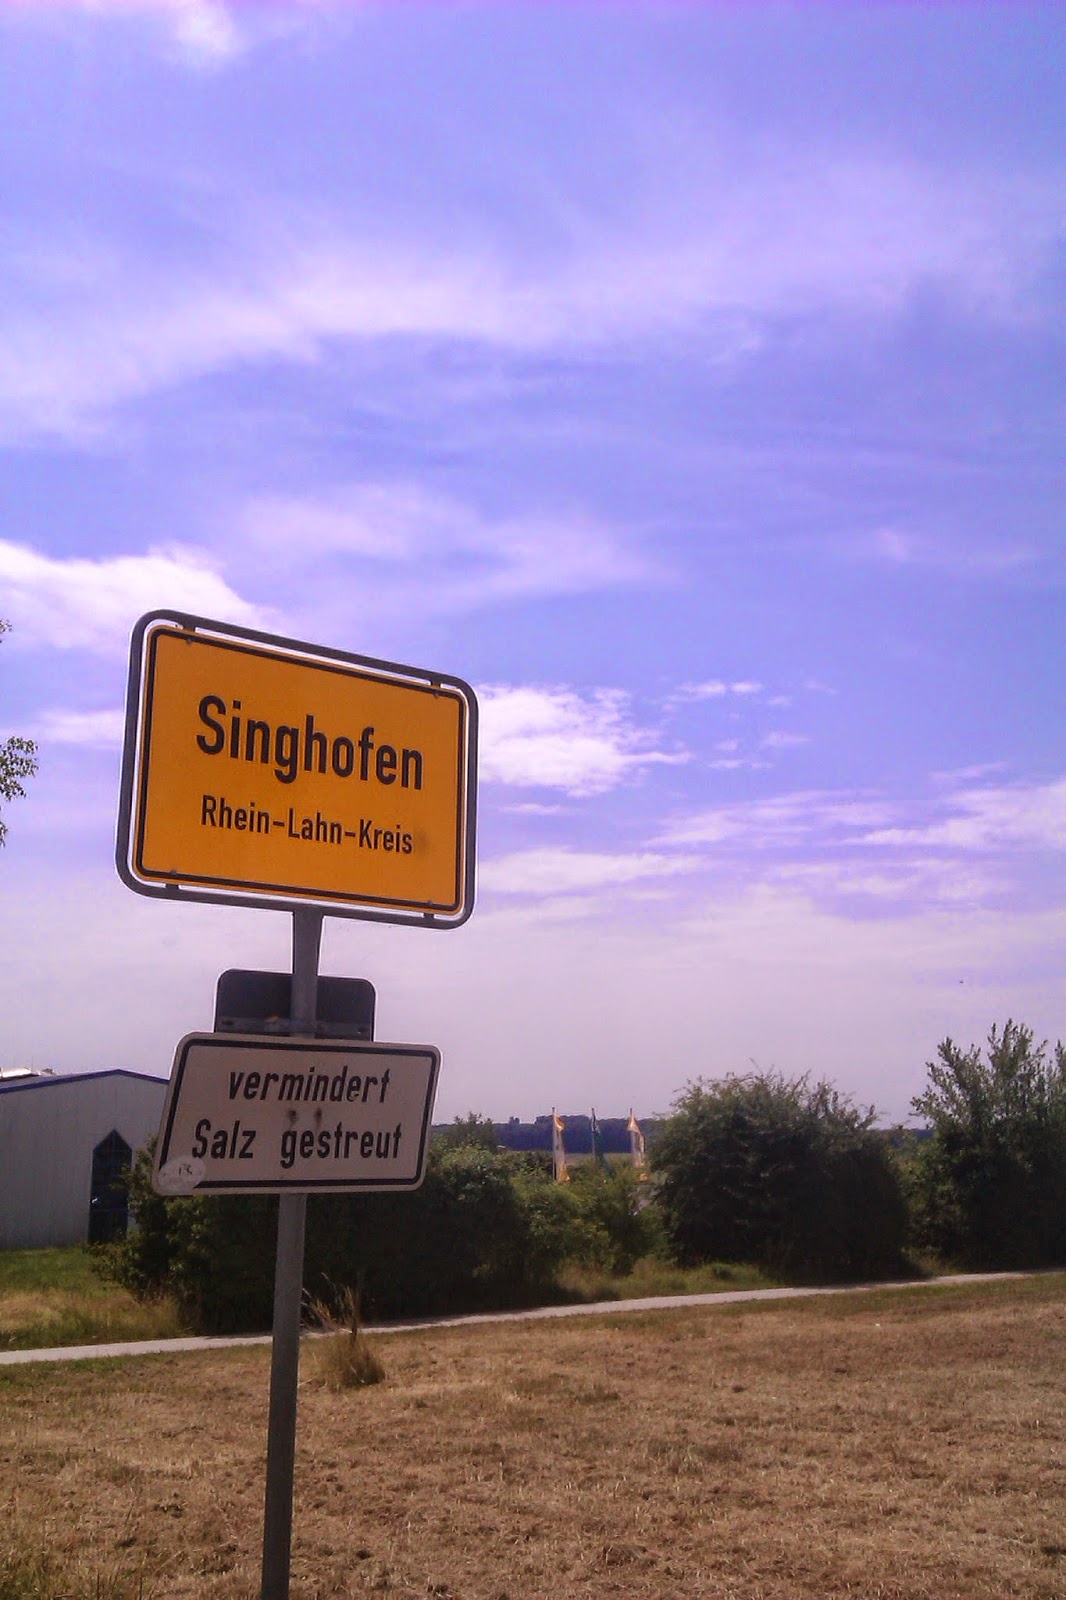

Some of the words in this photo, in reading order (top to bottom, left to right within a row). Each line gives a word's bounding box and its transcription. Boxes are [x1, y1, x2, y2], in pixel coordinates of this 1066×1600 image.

[196, 694, 423, 790] Singhofen
[201, 794, 413, 854] Rhein-Lahn-Kreis
[229, 1066, 390, 1103] vermindert
[192, 1119, 257, 1159] Salz
[279, 1121, 402, 1169] gestreut
